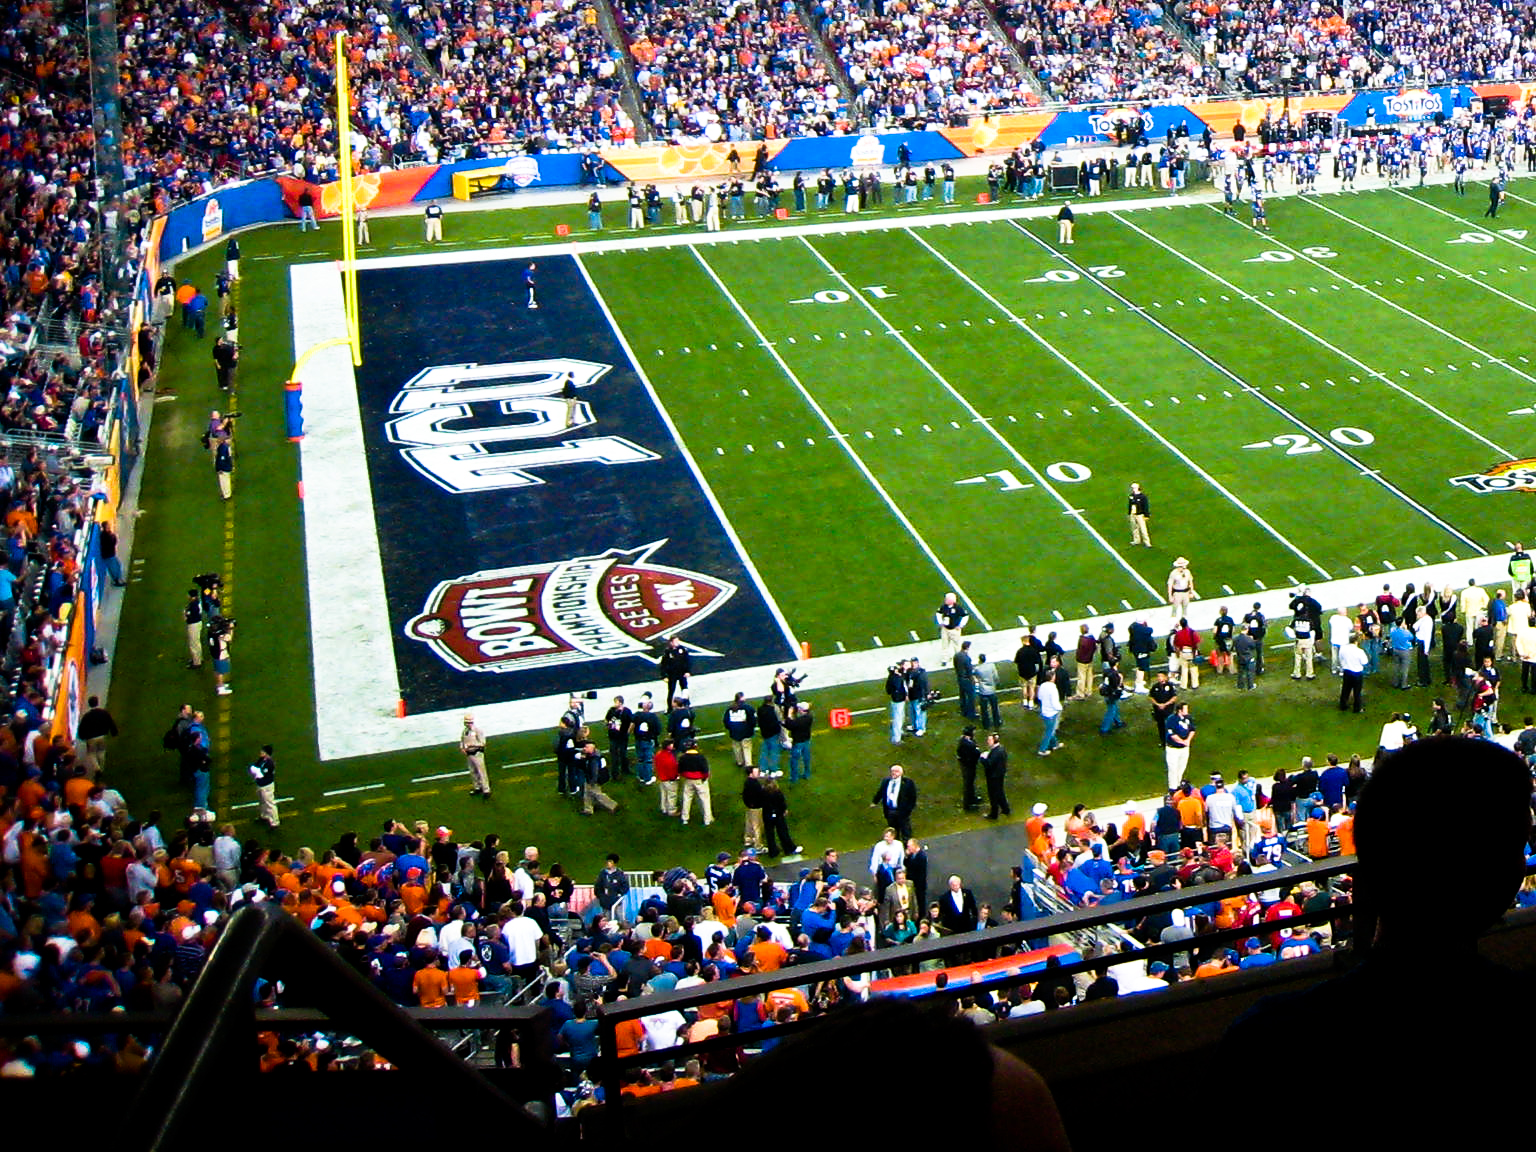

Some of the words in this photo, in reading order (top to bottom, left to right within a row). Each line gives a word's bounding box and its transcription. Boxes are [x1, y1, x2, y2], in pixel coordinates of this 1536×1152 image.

[384, 358, 662, 493] TCU
[1272, 427, 1375, 455] 20
[986, 462, 1091, 491] 10
[553, 563, 630, 650] CHAMPIONSHIP
[611, 573, 660, 629] SERIES
[654, 580, 698, 611] FOX
[460, 578, 559, 657] BOWL
[834, 711, 848, 726] G
[1263, 844, 1283, 861] 79
